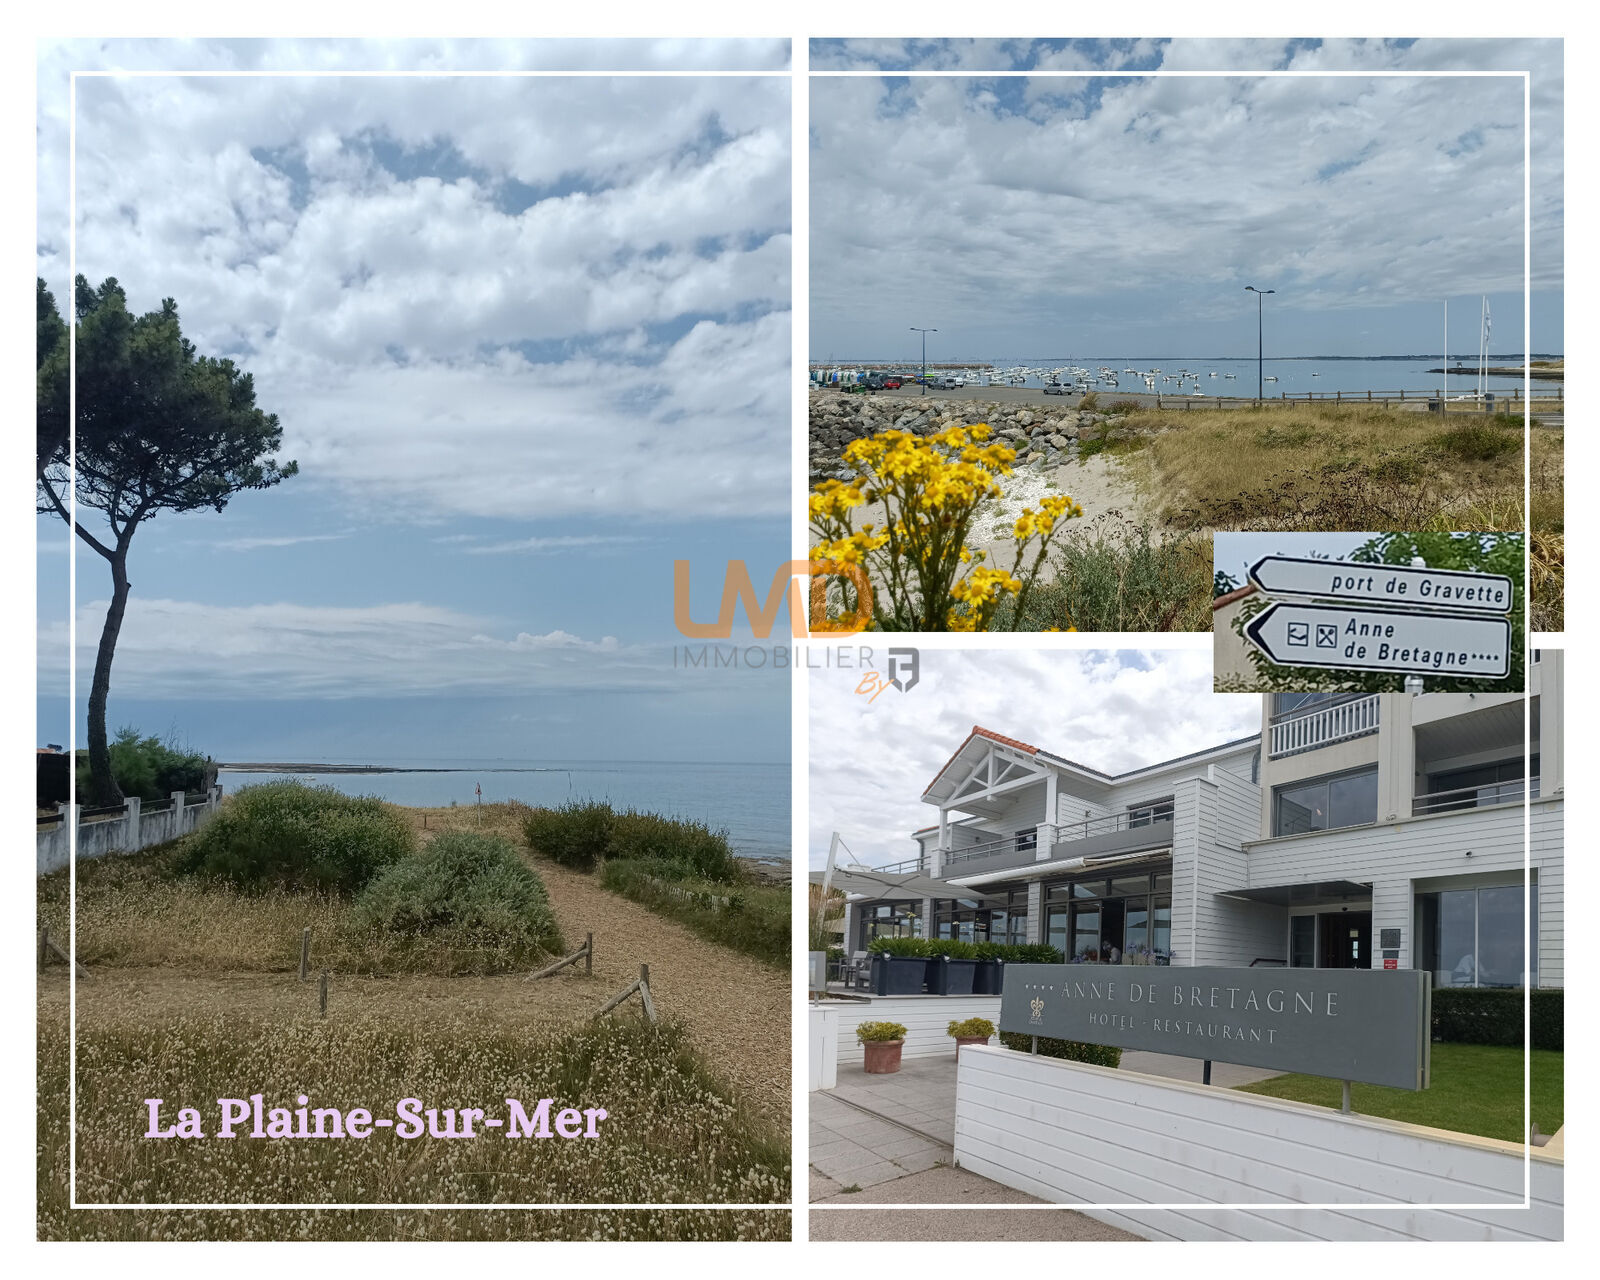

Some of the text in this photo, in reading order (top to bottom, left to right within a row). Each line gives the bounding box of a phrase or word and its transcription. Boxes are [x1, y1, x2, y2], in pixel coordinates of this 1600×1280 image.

[1331, 576, 1504, 603] port de Gravette
[1344, 618, 1395, 638] Anne
[1344, 641, 1367, 659] de
[1061, 982, 1338, 1016] ANNE DE BRETAGNE
[1088, 1012, 1135, 1031] HOTEL
[1153, 1018, 1278, 1044] RESTAURANT
